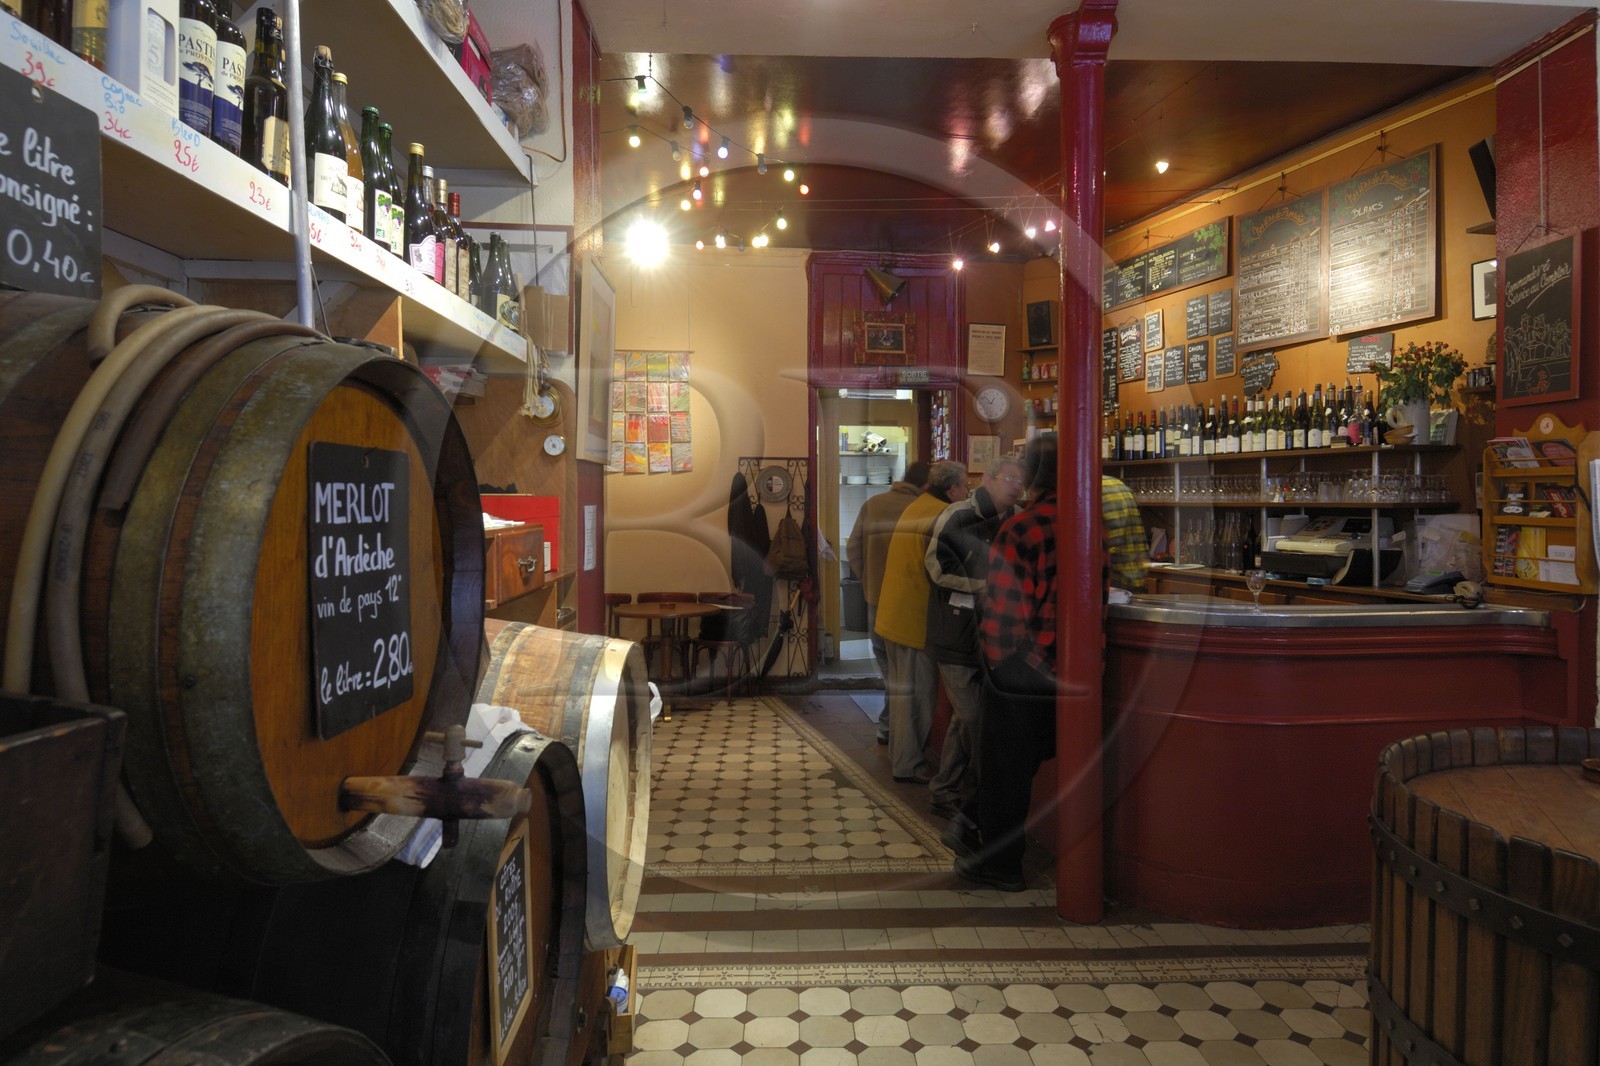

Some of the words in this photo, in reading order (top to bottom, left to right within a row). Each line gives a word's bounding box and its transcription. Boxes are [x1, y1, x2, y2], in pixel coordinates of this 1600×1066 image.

[0, 131, 12, 155] e
[23, 127, 76, 186] litre
[902, 370, 927, 378] SORTIE
[314, 481, 395, 524] MERLOT
[314, 532, 395, 579] d'Ardèche
[317, 596, 335, 619] vin
[339, 585, 353, 614] de
[358, 589, 383, 622] pays
[320, 666, 333, 704] le
